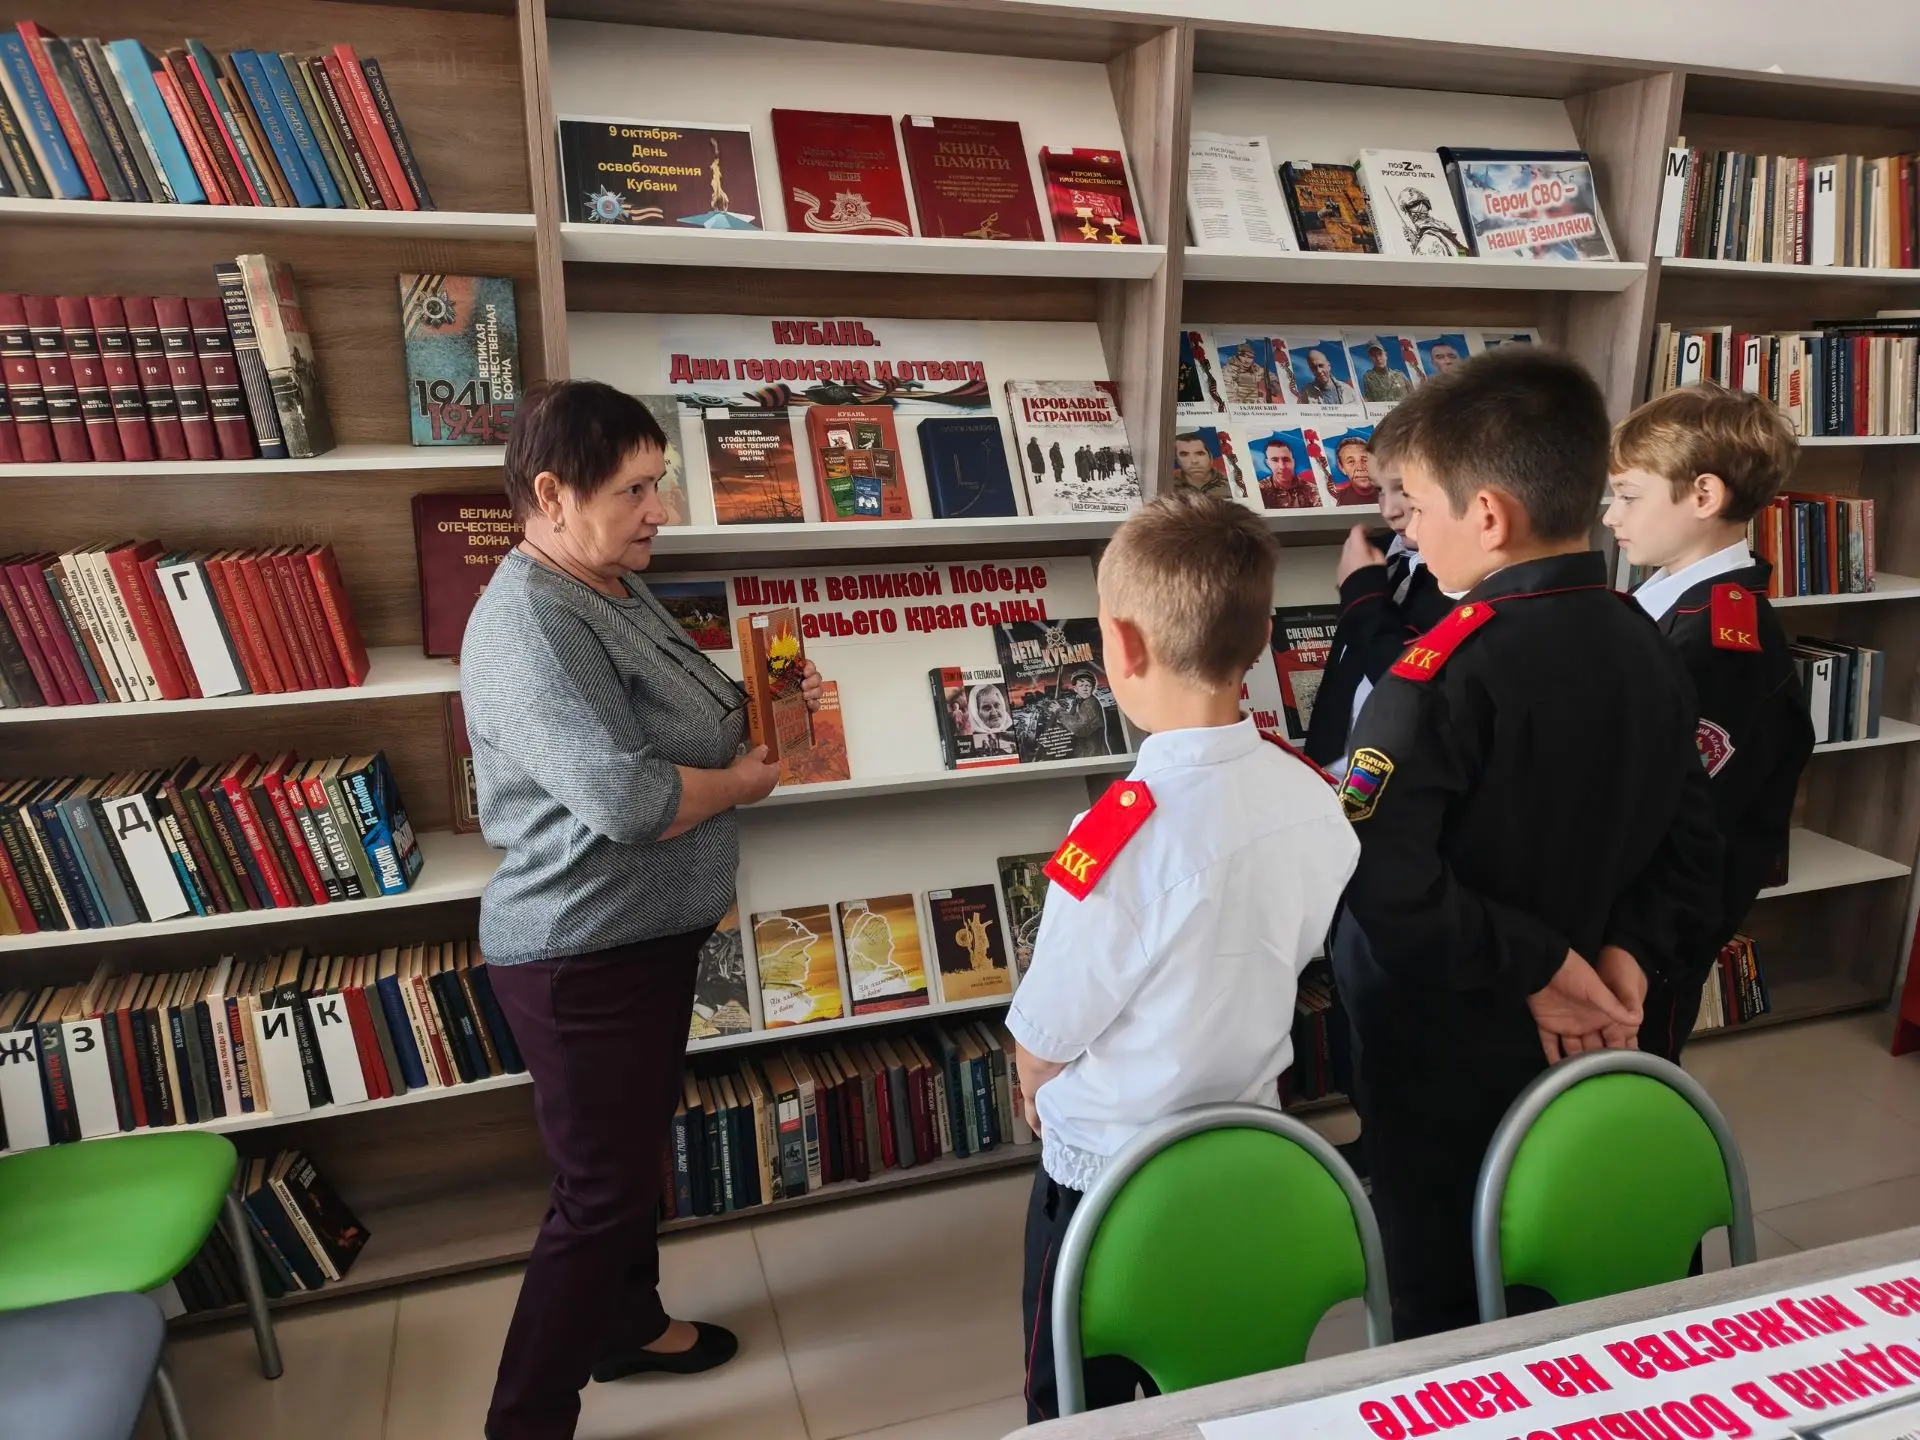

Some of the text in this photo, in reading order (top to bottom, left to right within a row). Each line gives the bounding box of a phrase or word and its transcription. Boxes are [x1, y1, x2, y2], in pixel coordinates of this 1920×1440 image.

[608, 126, 683, 142] 9 октября-
[632, 144, 668, 158] День
[938, 142, 1000, 156] КНИГА
[598, 161, 702, 177] освобождения
[933, 155, 1011, 170] ПАМЯТИ
[1381, 169, 1417, 178] РУССКОГО
[1667, 152, 1687, 178] М
[626, 178, 678, 192] Кубани
[1818, 170, 1832, 193] Н
[1484, 181, 1562, 218] Герои СВО
[1486, 216, 1594, 250] наши земляки
[772, 320, 881, 347] КУБАНЬ.
[475, 323, 489, 378] ВЕЛИКАЯ
[486, 304, 502, 400] ОТЕЧЕСТВЕННАЯ
[1686, 341, 1700, 364] О
[1746, 343, 1757, 366] П
[17, 365, 24, 373] 6
[50, 366, 56, 375] 7
[84, 367, 92, 376] 8
[116, 366, 123, 375] 9
[147, 366, 158, 375] 10
[177, 366, 186, 375] 11
[215, 366, 225, 374] 12
[501, 358, 514, 400] ВОЙНА
[669, 353, 986, 384] Дни героизма и отваги
[415, 379, 493, 418] 1941
[1789, 369, 1800, 408] ПАМЯТЬ
[1031, 397, 1109, 409] КРОВАВЫЕ
[1033, 410, 1112, 422] СТРАНИЦЫ
[427, 402, 515, 441] 1945
[734, 429, 763, 437] КУБАНЬ
[720, 442, 779, 450] ОТЕЧЕСТВЕННОЙ
[724, 436, 746, 444] ГОДЫ
[747, 435, 780, 443] ВЕЛИКОЙ
[437, 521, 526, 533] ОТЕЧЕСТВЕНН
[468, 534, 510, 546] ВОЙНА
[463, 554, 507, 565] 1941-19
[68, 568, 86, 596] ПОБЕДА
[85, 567, 103, 595] ПОБЕДА
[102, 567, 119, 593] ПОБЕДА
[171, 571, 190, 601] Г
[733, 565, 1047, 606] Шли к великой Победе
[801, 599, 1047, 639] ачьего края сыны
[1286, 626, 1324, 640] СПЕЦНАЗ
[1297, 640, 1333, 651] Афганист
[1009, 639, 1094, 668] ДЕТИ КУБАНИ
[1023, 662, 1046, 671] Великой
[147, 675, 155, 687] 3
[1016, 667, 1055, 678] Отечественной
[1816, 663, 1829, 681] Ч
[1709, 731, 1721, 759] КЛАСС
[1357, 760, 1381, 775] КЛАСС
[117, 801, 152, 840] Д
[165, 813, 197, 872] ЗЕЛЕНАЯ БРАМА
[216, 822, 239, 855] ВОЕННОЙ
[300, 816, 330, 871] ТАНКИСТЫ
[317, 812, 350, 871] САПЕРЫ
[374, 845, 403, 888] ДРАБКИН
[1056, 842, 1098, 883] КК
[261, 1012, 289, 1040] И
[317, 1000, 343, 1027] К
[0, 1036, 35, 1066] Ж
[72, 1027, 95, 1052] З
[1603, 1295, 1869, 1379] мужества
[1524, 1354, 1613, 1397] на
[1767, 1339, 1920, 1411] одина
[1359, 1371, 1533, 1440] карте
[1731, 1381, 1792, 1420] в
